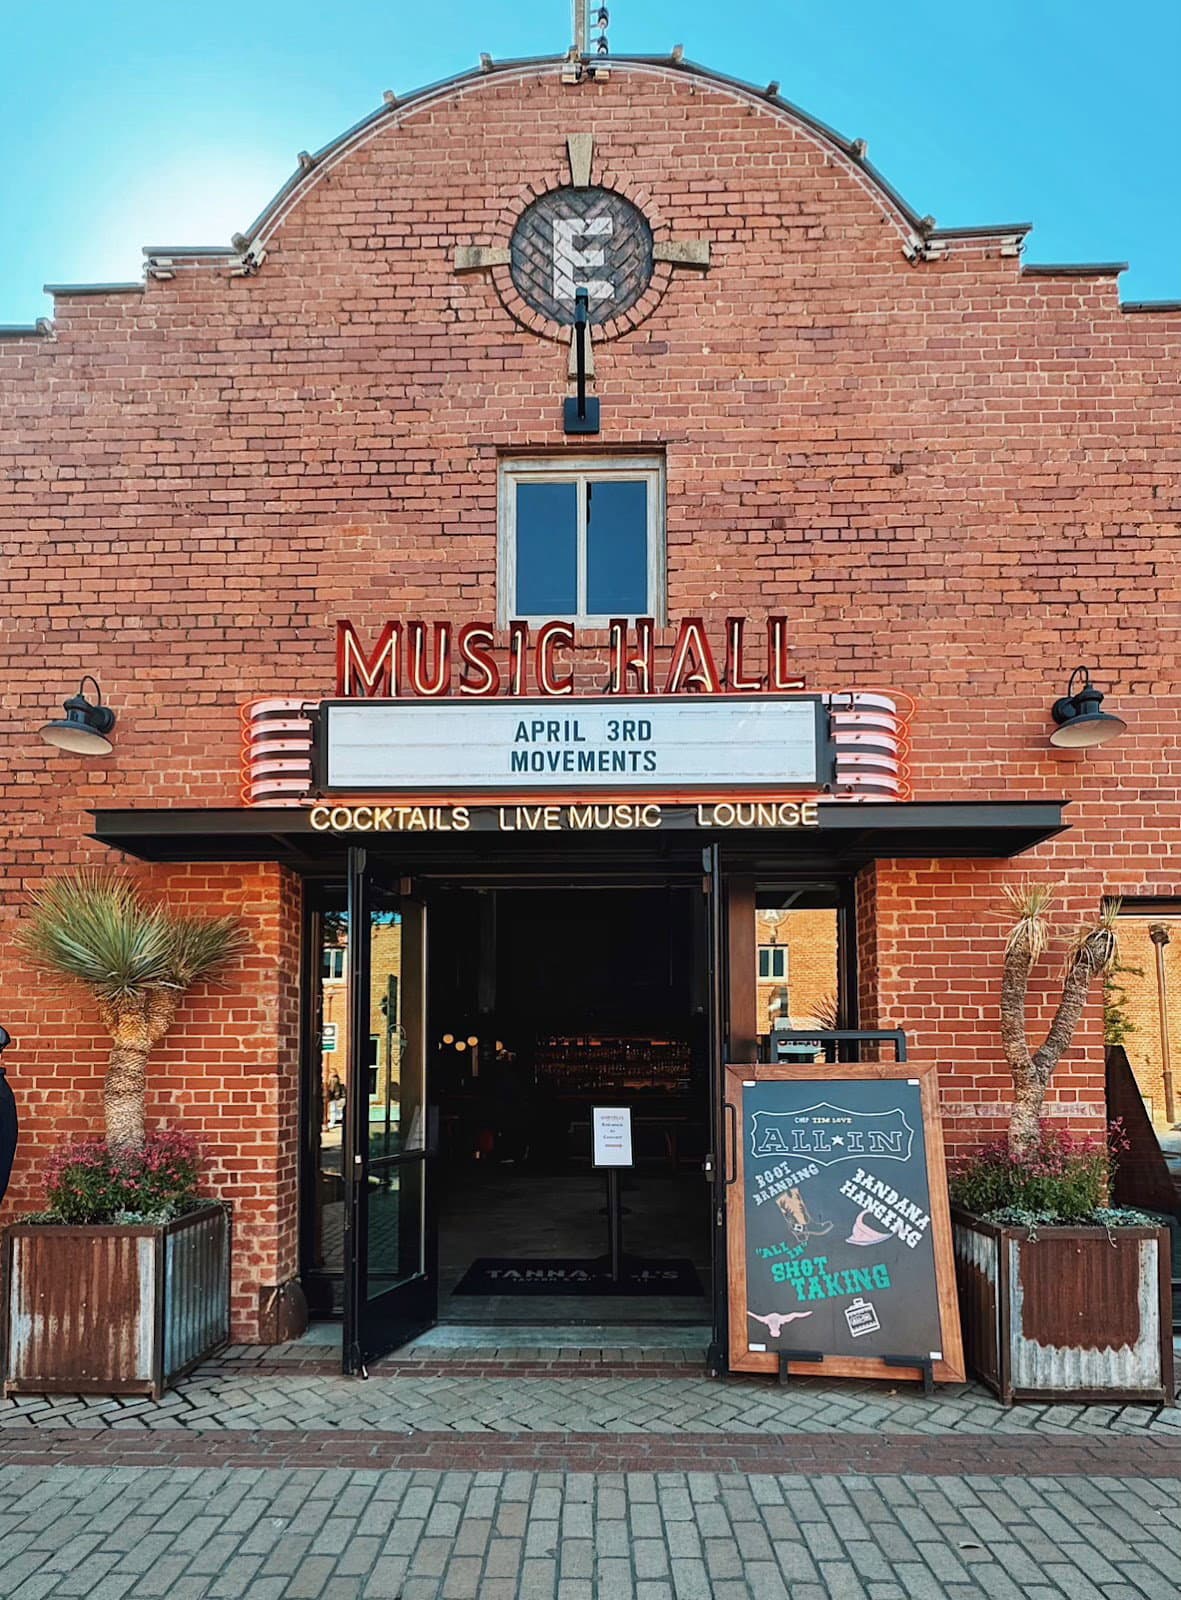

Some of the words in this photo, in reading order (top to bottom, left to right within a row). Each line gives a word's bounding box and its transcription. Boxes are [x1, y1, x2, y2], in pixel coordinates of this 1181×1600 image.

[336, 619, 575, 697] MUSIC
[609, 616, 806, 694] HALL
[514, 720, 586, 742] APRIL
[607, 720, 652, 741] 3RD
[511, 750, 657, 772] MOVEMENTS
[309, 806, 471, 831] COCKTAILS
[499, 806, 563, 831] LIVE
[568, 804, 663, 829] MUSIC
[697, 802, 819, 826] LOUNGE
[758, 1128, 832, 1151] ALL
[847, 1131, 902, 1152] IN
[752, 1163, 820, 1206] BRANDING
[755, 1161, 792, 1188] BOOT
[851, 1167, 931, 1231] BANDANA
[771, 1256, 828, 1282] SHOT
[791, 1263, 891, 1301] TAKING
